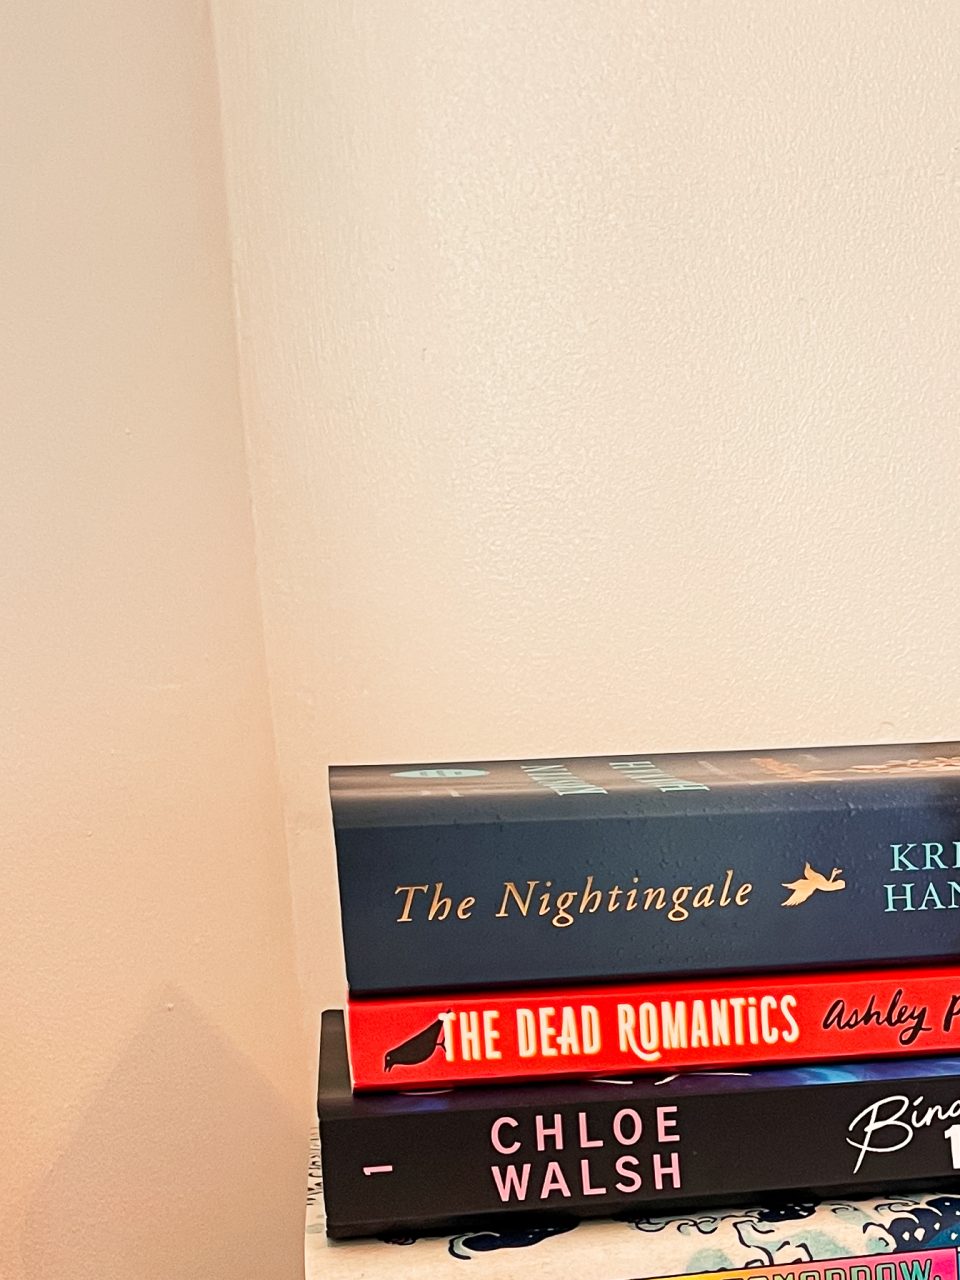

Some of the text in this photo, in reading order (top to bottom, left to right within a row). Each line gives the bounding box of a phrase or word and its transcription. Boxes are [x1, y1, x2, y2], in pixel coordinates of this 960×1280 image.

[394, 869, 754, 928] The Nightingale
[438, 1009, 502, 1062] THE
[515, 1004, 601, 1058] DEAD
[822, 988, 932, 1046] Ashley
[491, 1105, 681, 1155] CHLOE
[363, 1164, 394, 1177] 1
[491, 1152, 683, 1202] WALSH
